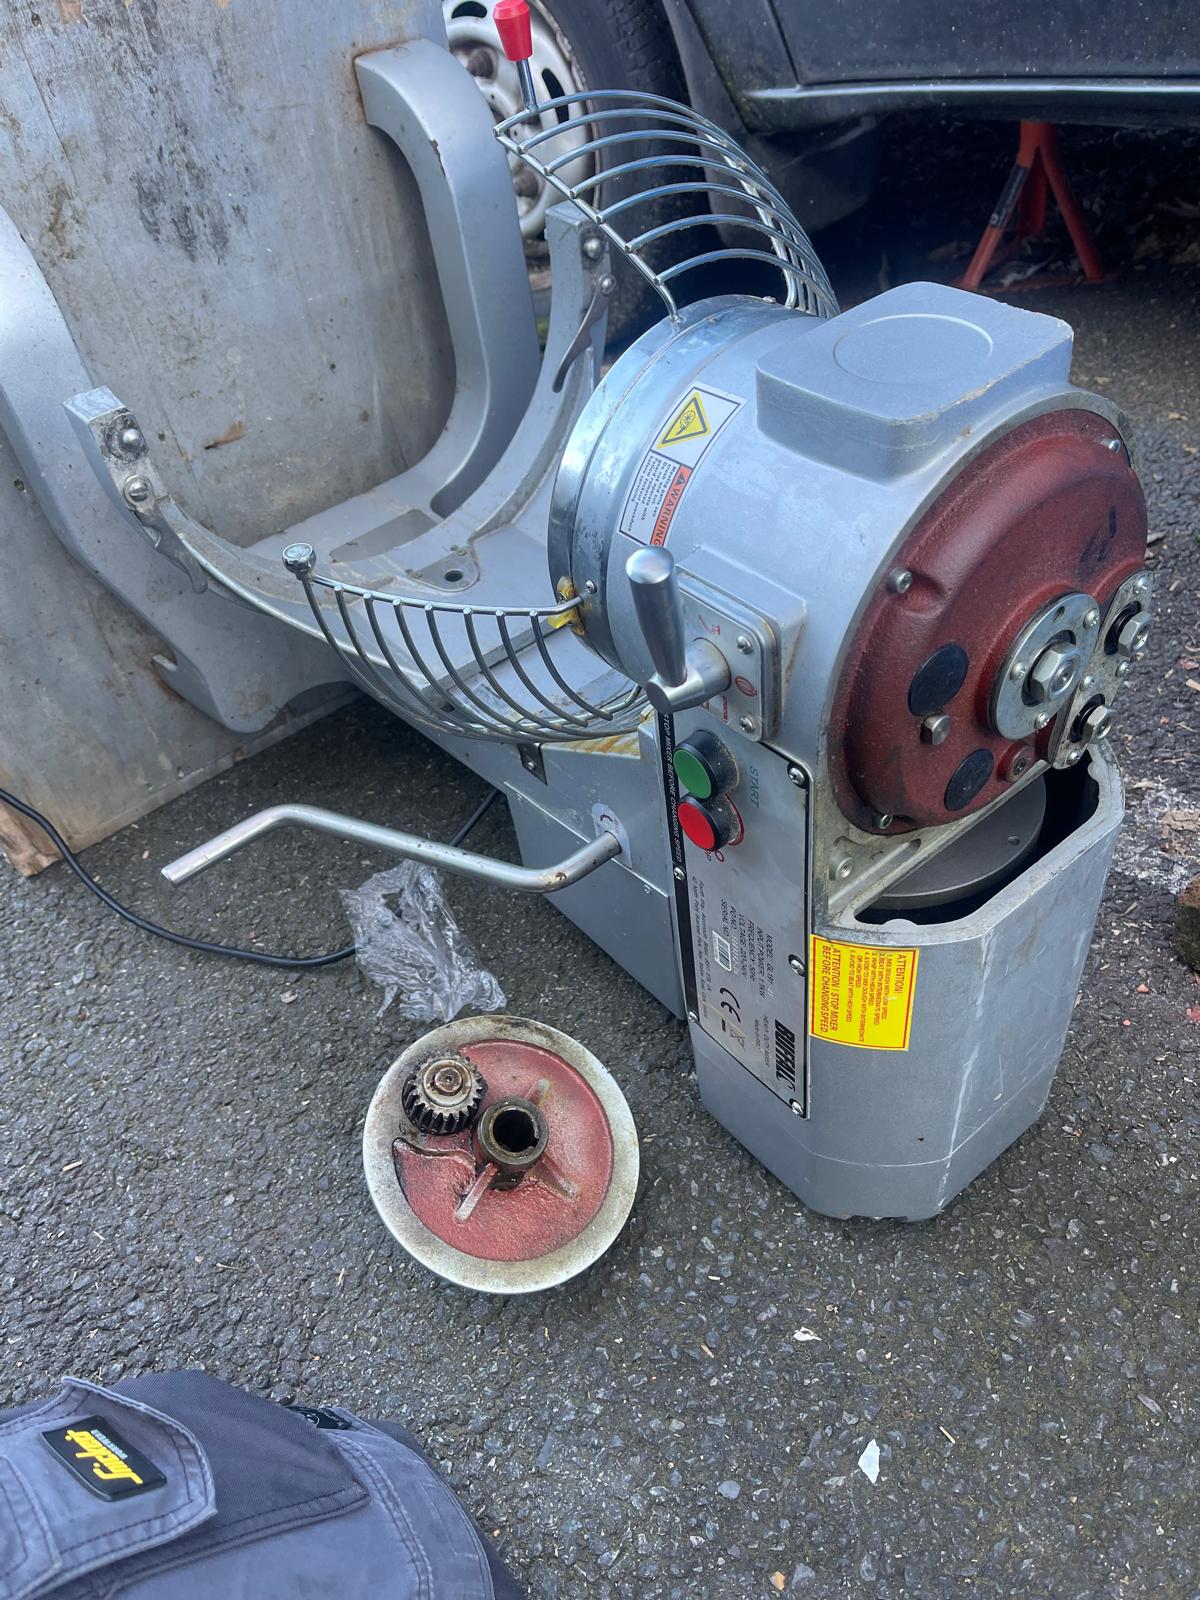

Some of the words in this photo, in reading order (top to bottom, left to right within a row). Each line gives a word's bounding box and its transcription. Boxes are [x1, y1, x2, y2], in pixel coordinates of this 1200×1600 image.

[654, 488, 680, 544] WARNING
[667, 763, 675, 796] BEFORE
[671, 797, 679, 837] CHANGING
[750, 766, 760, 808] START
[822, 946, 831, 975] BEFORE
[831, 948, 840, 988] ATTENTION
[894, 955, 906, 994] ATTENTION!
[821, 976, 830, 1010] CHANGING
[830, 992, 839, 1010] STOP
[830, 1011, 838, 1031] MIXER
